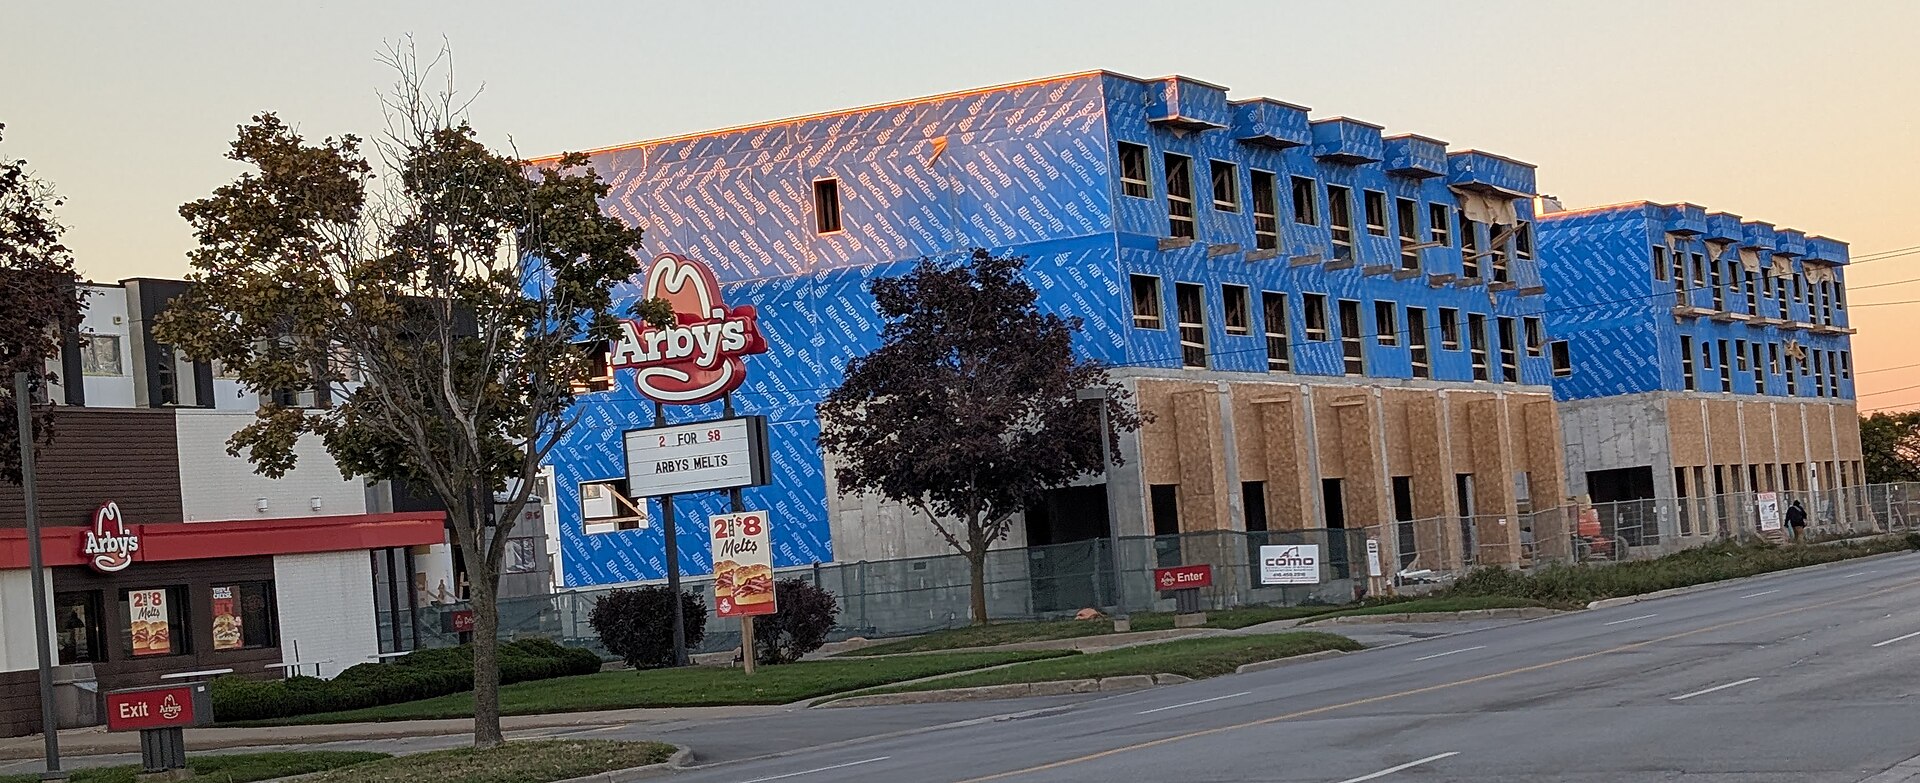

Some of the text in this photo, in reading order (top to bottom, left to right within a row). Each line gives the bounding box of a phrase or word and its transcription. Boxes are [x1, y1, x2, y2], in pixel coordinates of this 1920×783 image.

[968, 92, 992, 115] BlueG
[1049, 79, 1073, 102] BlueG
[828, 114, 852, 136] BlueG
[892, 104, 916, 126] BlueG
[678, 138, 701, 160] BlueG
[750, 126, 774, 149] BlueG
[979, 151, 1012, 188] BlueGlass
[1012, 153, 1046, 192] BlueGlass
[1025, 142, 1060, 180] BlueGlass
[1060, 148, 1094, 186] BlueGlass
[1073, 138, 1108, 176] BlueGlass
[858, 172, 890, 208] BlueGlass
[870, 161, 902, 198] BlueGlass
[904, 164, 936, 201] BlueGlass
[966, 161, 999, 199] BlueGlass
[684, 195, 716, 230] BlueGlass
[724, 189, 755, 226] BlueGlass
[735, 180, 767, 216] BlueGlass
[768, 189, 800, 226] BlueGlass
[1030, 195, 1064, 233] BlueGlass
[1078, 190, 1112, 229] BlueGlass
[650, 211, 672, 237] eGlass
[875, 212, 907, 249] BlueGlass
[908, 216, 941, 253] BlueGlass
[921, 206, 954, 242] BlueGlass
[983, 202, 1016, 240] BlueGlass
[700, 234, 730, 270] BlueGlass
[740, 229, 772, 266] BlueGlass
[823, 235, 850, 262] eGlass
[841, 227, 862, 252] BlueG
[863, 222, 896, 260] BlueGlass
[729, 240, 760, 276] BlueGlass
[1066, 266, 1088, 289] Glass
[826, 305, 858, 342] BlueGlass
[1072, 292, 1106, 331] BlueGlass
[613, 308, 745, 366] Arby's
[762, 320, 795, 358] BlueGlass
[798, 348, 820, 376] BlueG
[659, 430, 720, 447] 2 FOR $8
[656, 454, 728, 474] ARBYS MELTS
[771, 450, 802, 488] BlueGlass
[783, 440, 815, 478] BlueGlass
[688, 510, 710, 533] BlueG
[714, 519, 728, 539] 2
[85, 529, 138, 558] Arby's
[561, 522, 590, 560] BlueGlass
[721, 538, 757, 558] Melts
[780, 542, 803, 566] BlueG
[606, 560, 628, 582] BlueG
[692, 552, 714, 574] BlueG
[1177, 572, 1204, 582] Enter
[134, 592, 143, 607] 2
[138, 606, 160, 620] Melts
[120, 702, 148, 718] Exit
